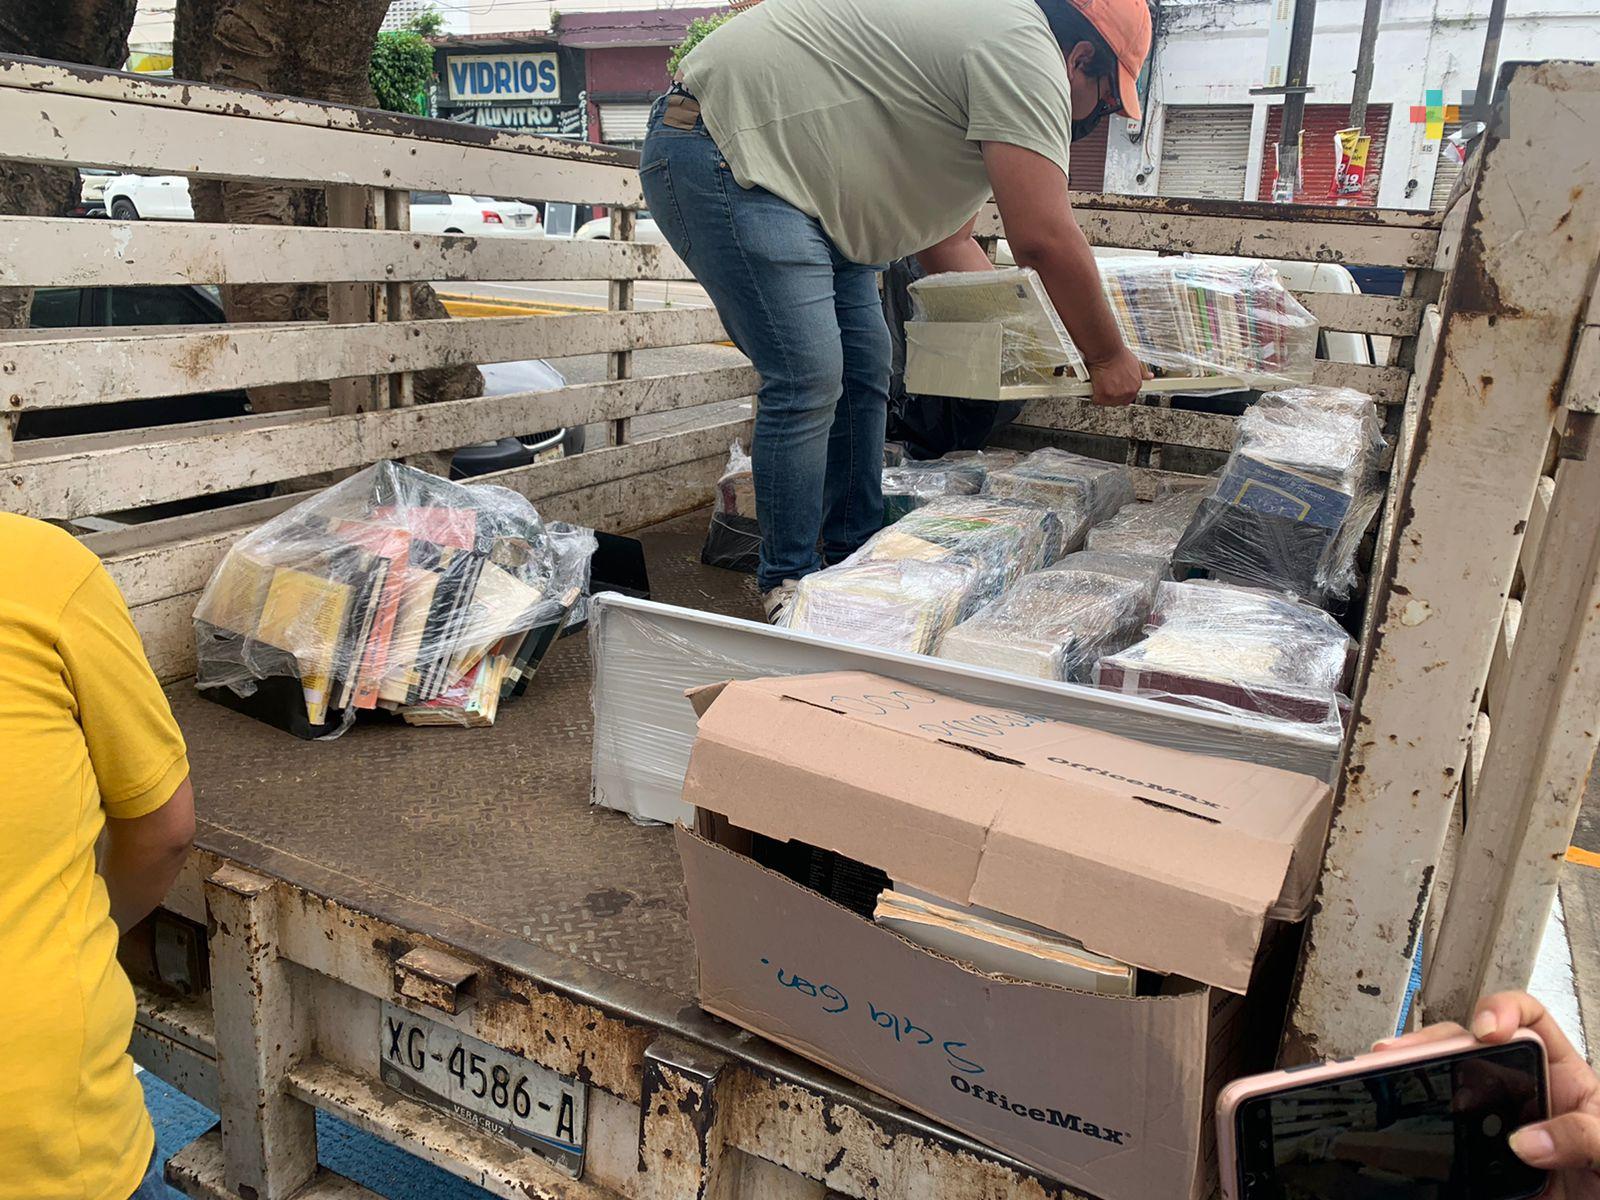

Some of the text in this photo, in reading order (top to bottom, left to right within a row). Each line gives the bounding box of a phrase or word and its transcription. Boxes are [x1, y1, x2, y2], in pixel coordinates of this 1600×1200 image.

[450, 60, 556, 94] VIDRIOS
[476, 107, 553, 126] ALUVITRO
[1047, 756, 1221, 809] OfficeMax
[388, 1016, 574, 1144] XG-4586-A
[453, 1105, 505, 1135] VERACRUZ
[950, 1075, 1124, 1145] OfficeMax
